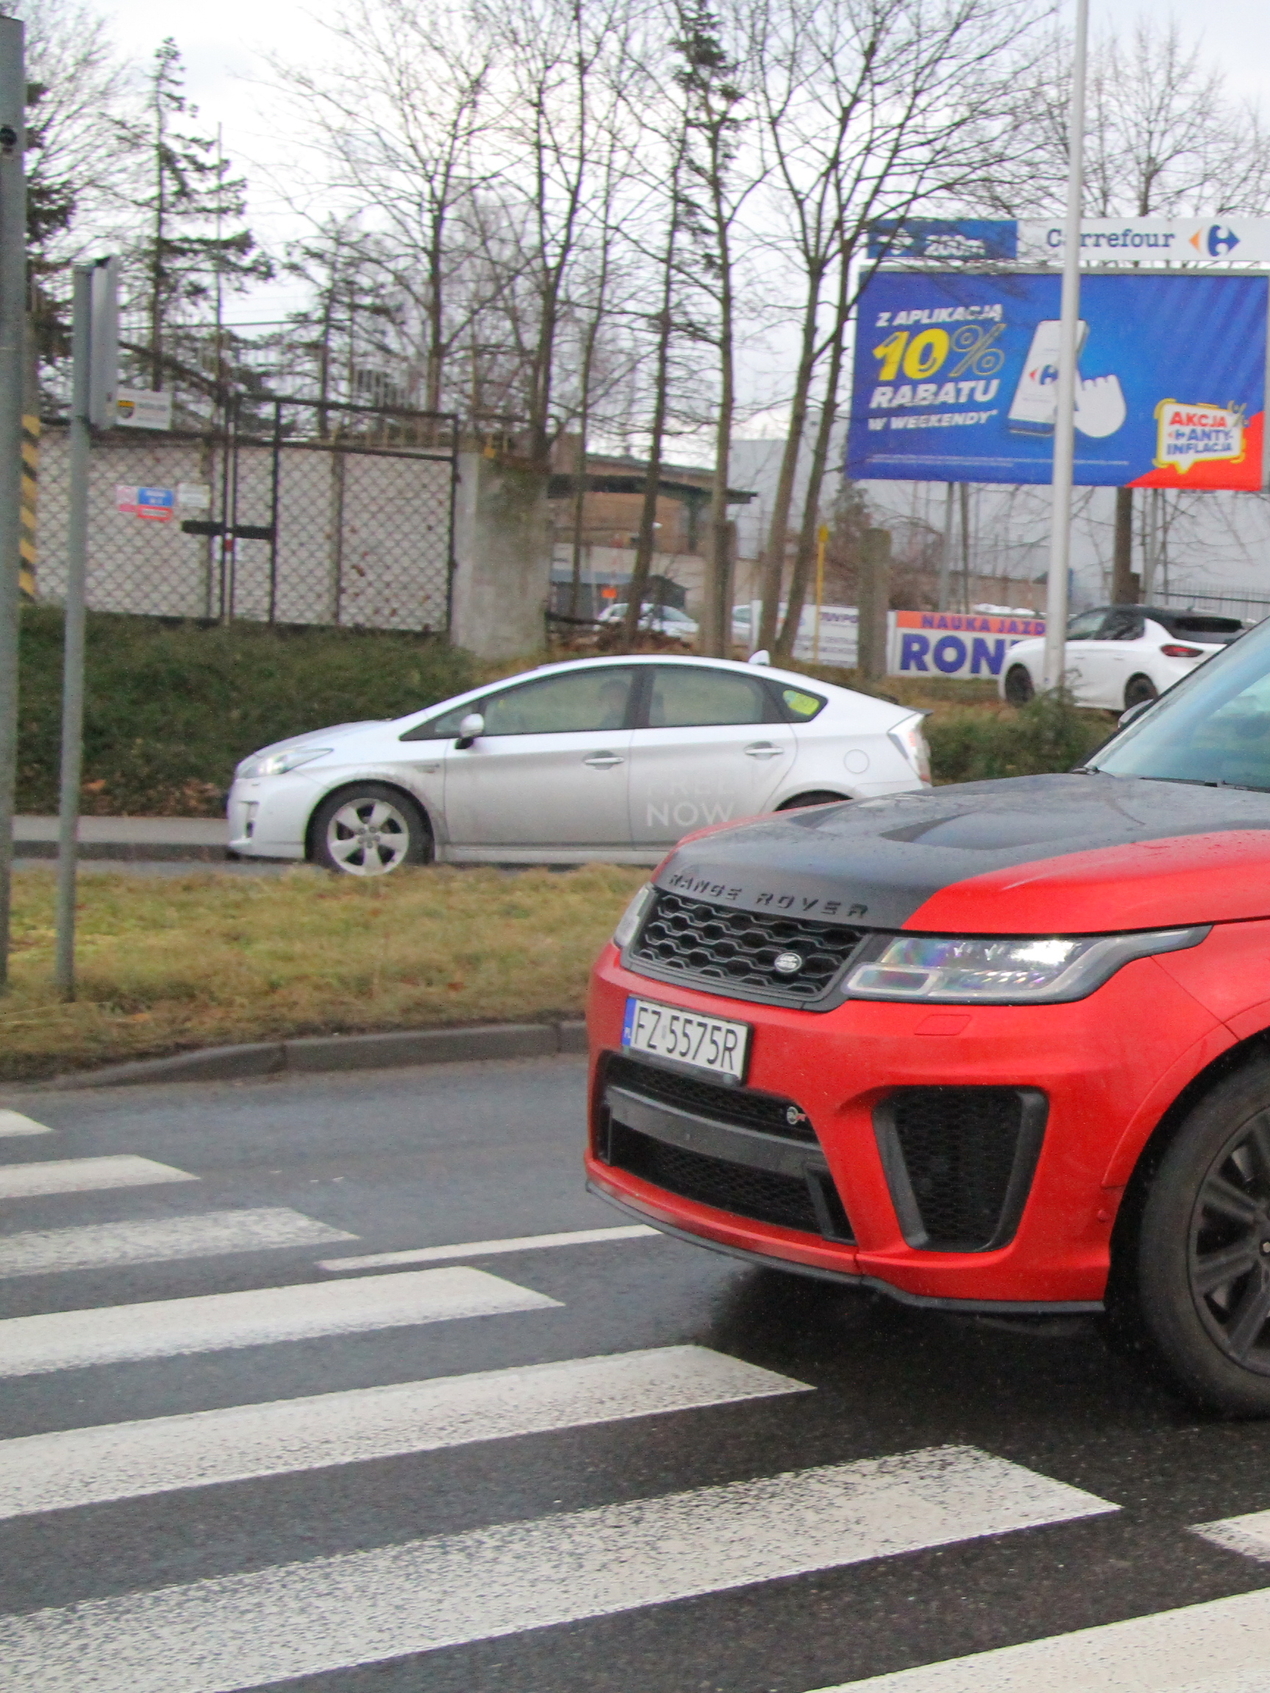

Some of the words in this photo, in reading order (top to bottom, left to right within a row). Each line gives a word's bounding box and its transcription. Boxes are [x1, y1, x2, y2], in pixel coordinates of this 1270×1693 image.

[1046, 228, 1176, 248] Crrefour
[875, 312, 892, 327] Z
[873, 323, 1007, 381] 10%
[869, 379, 1000, 409] RABATU
[867, 417, 887, 431] W
[1169, 411, 1228, 428] AKCJA
[1166, 442, 1232, 455] INFLACJA
[921, 614, 991, 633] NAUKA
[900, 633, 1024, 675] RON
[646, 802, 734, 827] NOW
[669, 874, 742, 901] RANGE
[755, 892, 869, 919] ROVER
[634, 1006, 662, 1050] FZ
[666, 1014, 738, 1071] 5575R
